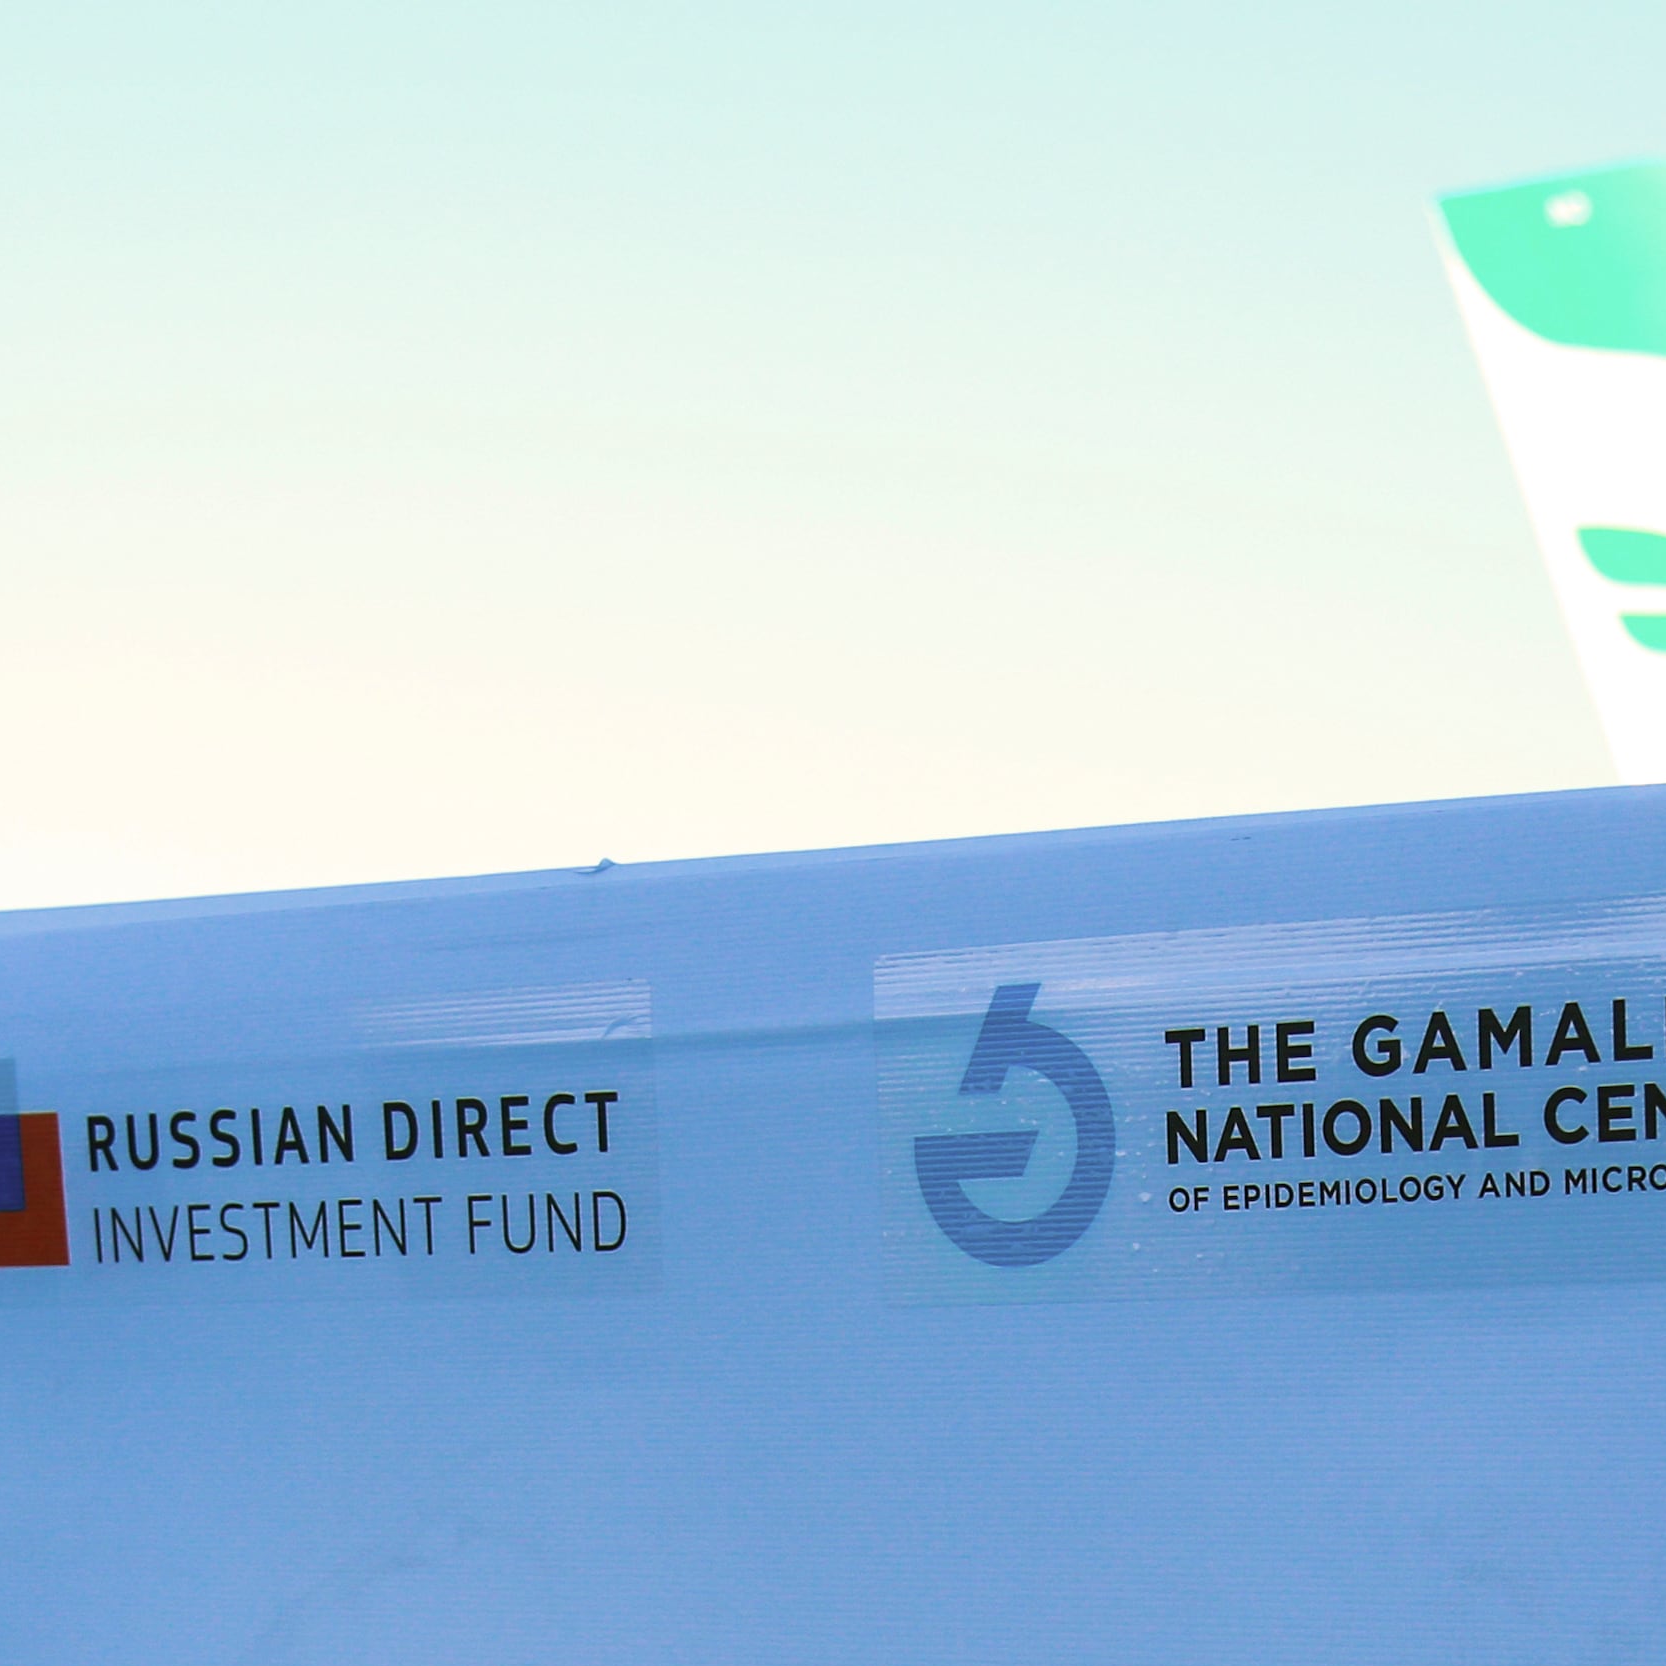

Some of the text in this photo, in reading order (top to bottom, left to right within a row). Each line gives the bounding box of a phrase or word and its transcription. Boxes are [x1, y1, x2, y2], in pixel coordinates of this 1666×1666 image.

[1165, 1020, 1316, 1088] THE
[86, 1091, 619, 1172] RUSSIAN DIRECT
[1167, 1092, 1519, 1164] NATIONAL
[1168, 1187, 1210, 1212] OF
[1223, 1173, 1466, 1210] EPIDEMIOLOGY
[1478, 1169, 1549, 1198] AND
[93, 1190, 627, 1264] INVESTMENT FUND
